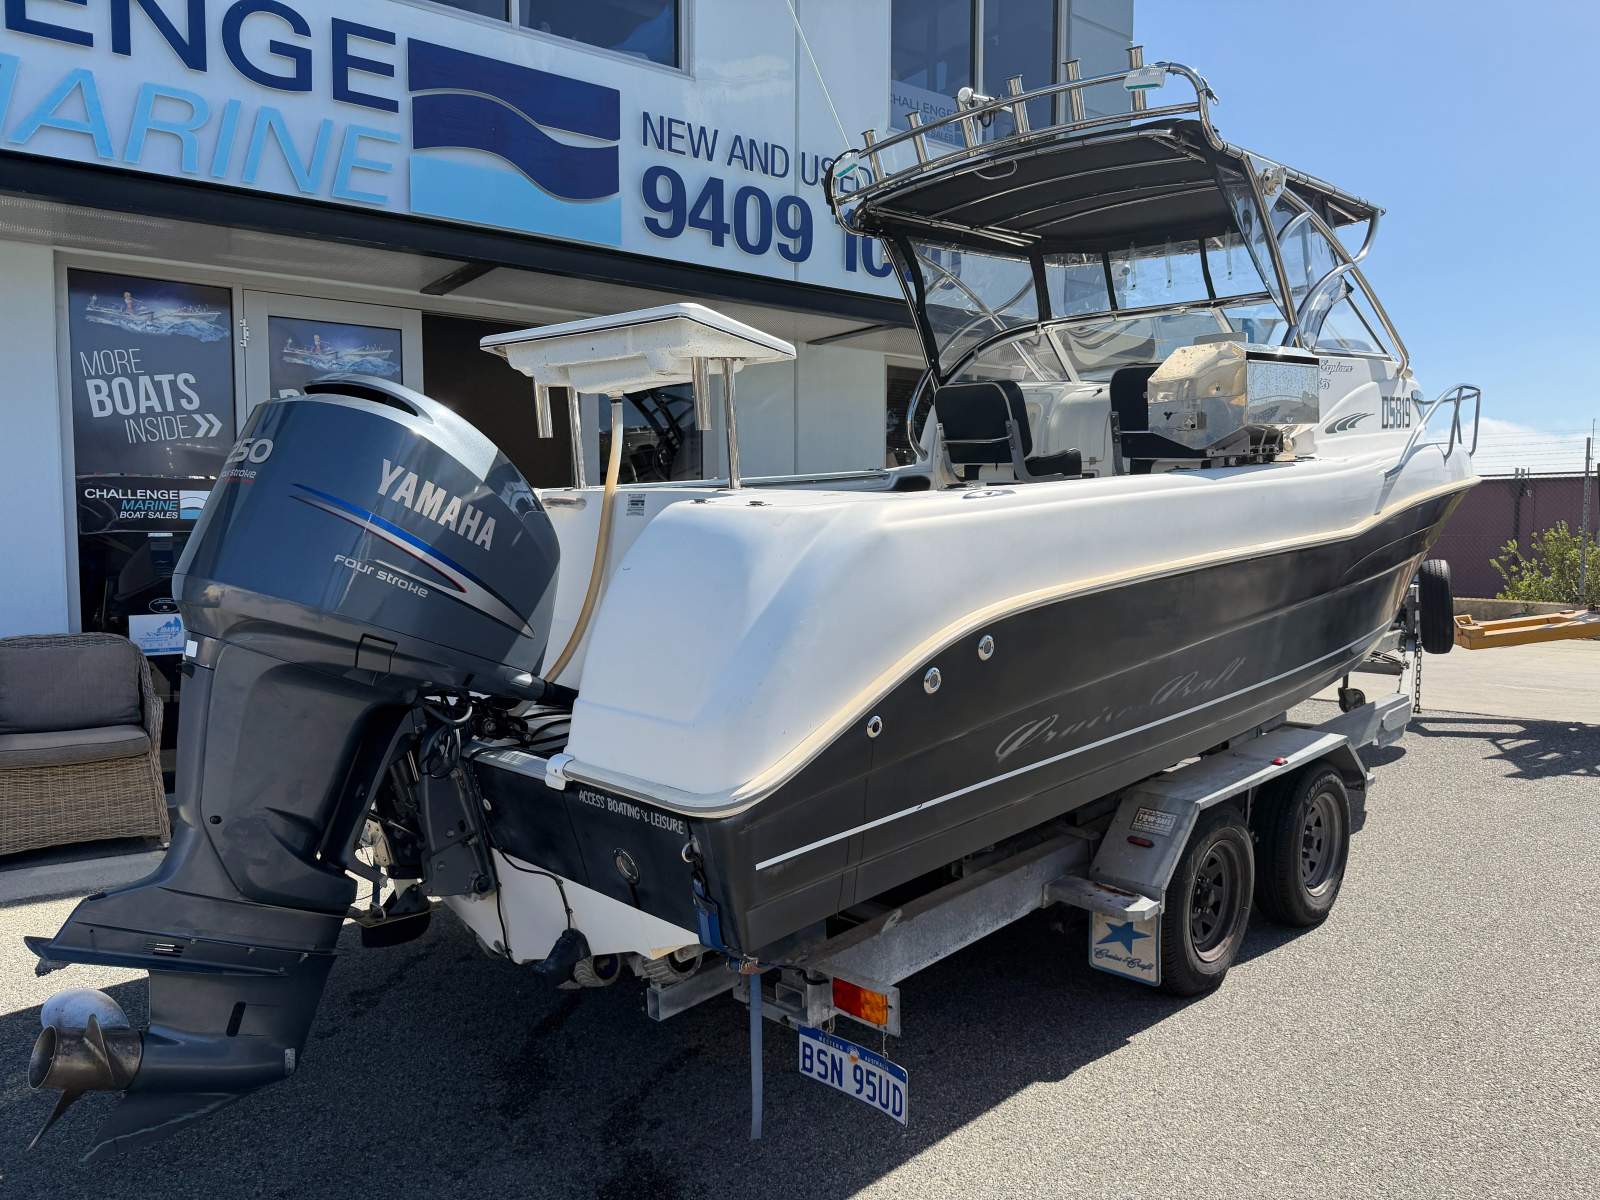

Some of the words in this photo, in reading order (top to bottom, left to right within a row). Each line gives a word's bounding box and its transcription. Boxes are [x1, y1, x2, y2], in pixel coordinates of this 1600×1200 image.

[642, 111, 719, 162] NEW
[727, 134, 790, 180] AND
[641, 165, 814, 263] 9409
[80, 349, 145, 376] MORE
[86, 373, 200, 418] BOATS
[125, 415, 192, 444] INSIDE
[84, 488, 179, 500] CHALLENGE
[120, 511, 146, 519] BOAT
[147, 511, 179, 519] SALES
[121, 500, 179, 511] MARINE
[377, 458, 497, 551] YAMAHA
[579, 789, 605, 809] ACCESS
[606, 798, 641, 820] BOATING
[651, 811, 685, 835] LEISURE
[801, 1041, 844, 1088] BSN
[852, 1063, 903, 1118] 95UD
